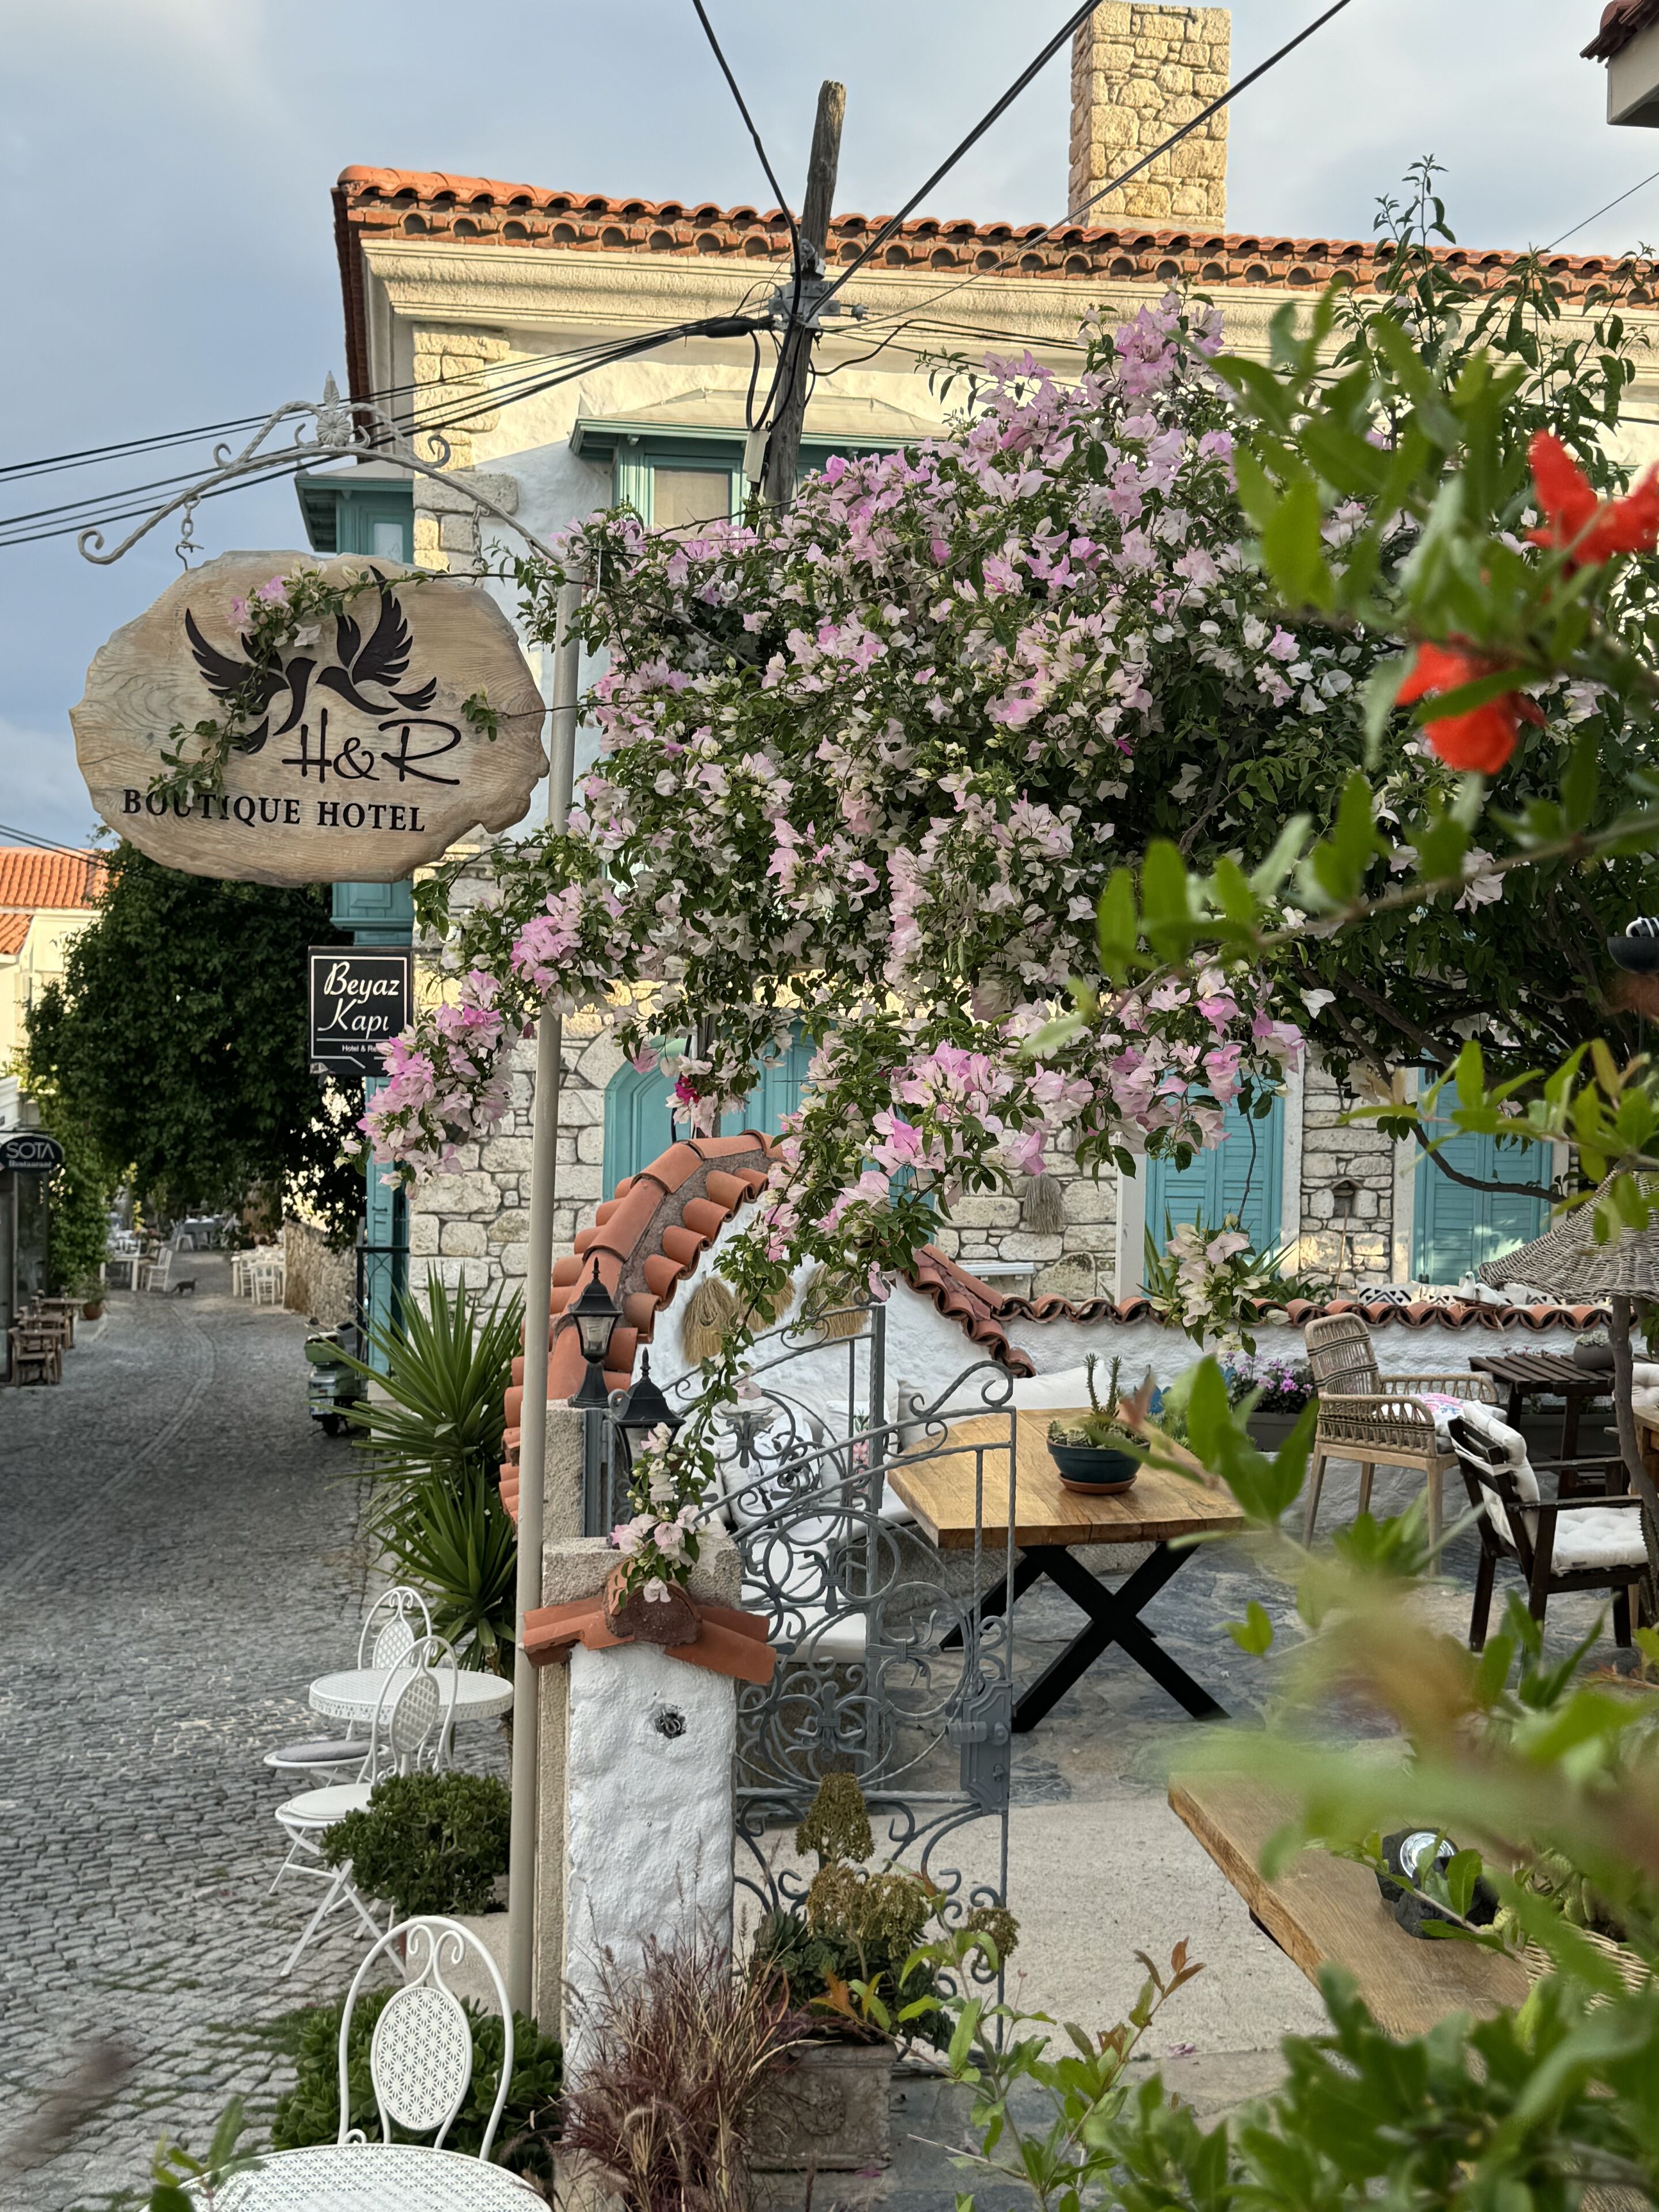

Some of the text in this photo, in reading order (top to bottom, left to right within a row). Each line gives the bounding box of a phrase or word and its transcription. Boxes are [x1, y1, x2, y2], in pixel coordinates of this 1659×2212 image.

[282, 708, 461, 785] H&R
[122, 789, 425, 831] BOUTIQUE HOTEL
[324, 961, 400, 1003] Beyaz
[6, 1141, 55, 1159] SOTA
